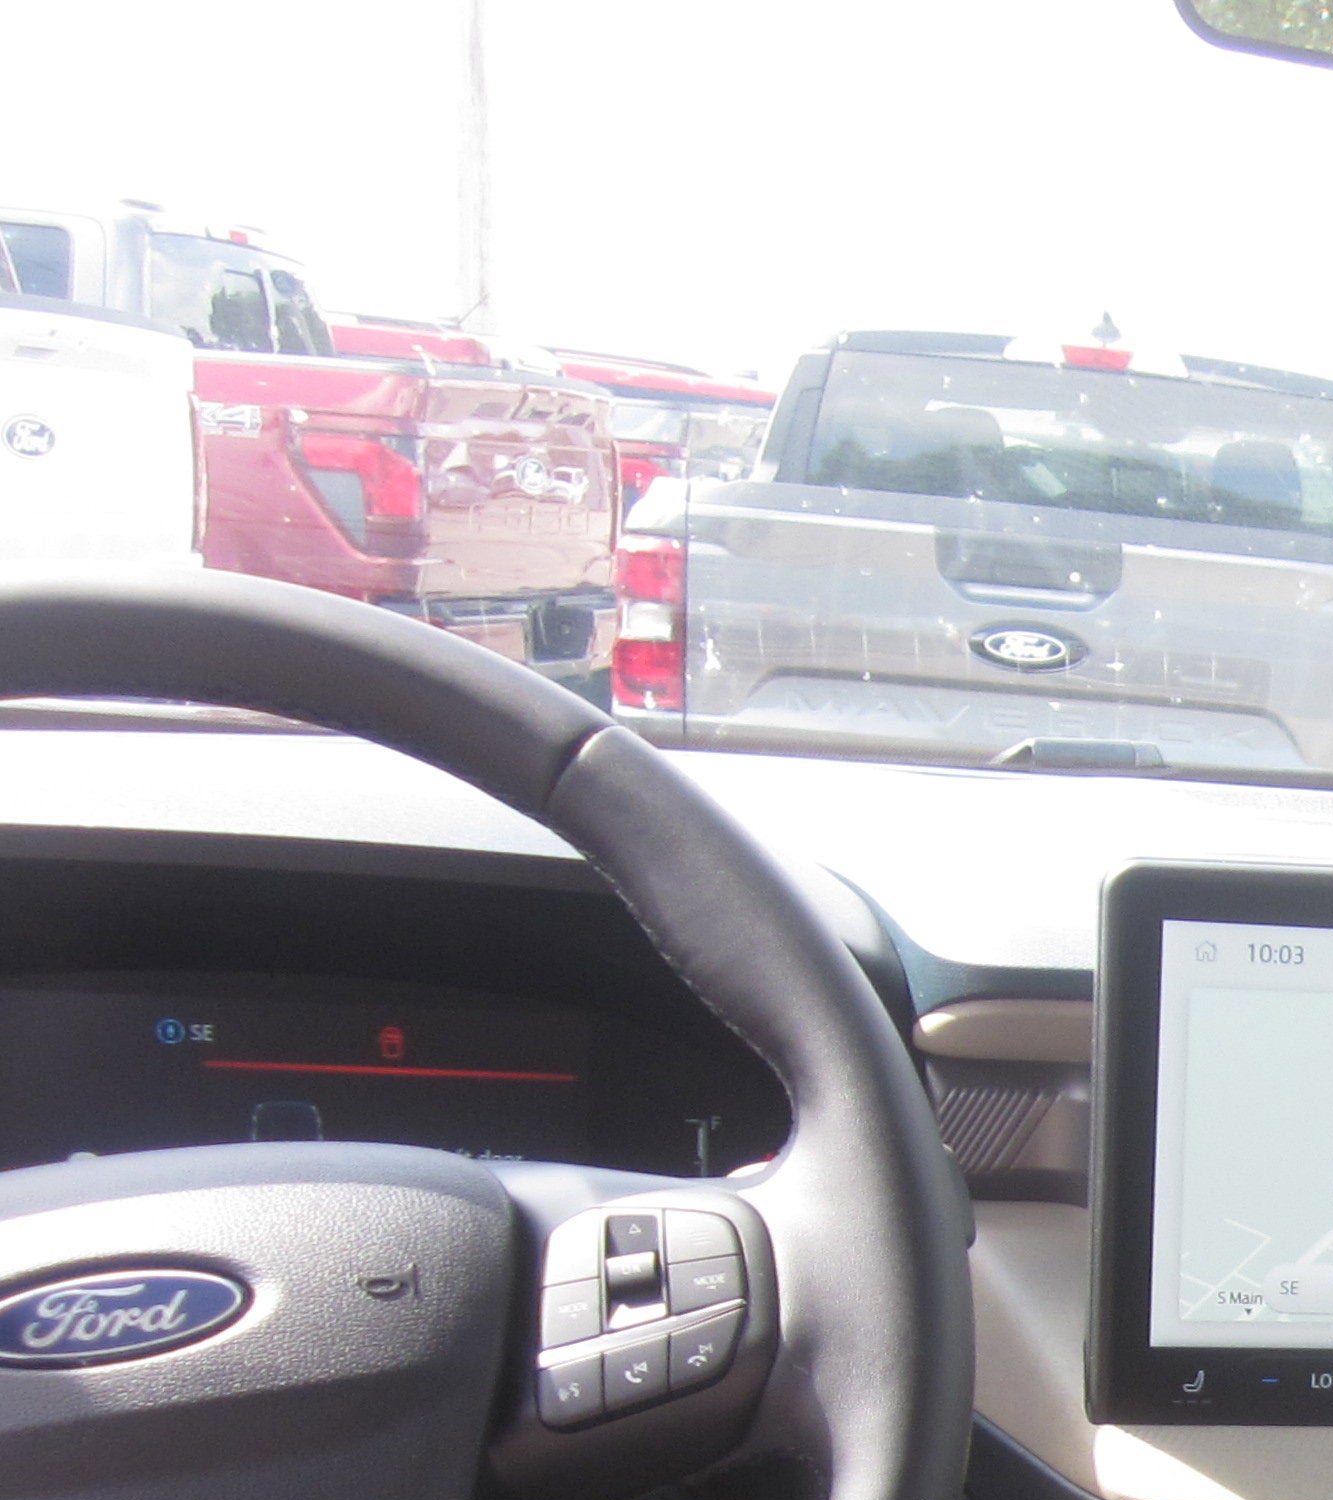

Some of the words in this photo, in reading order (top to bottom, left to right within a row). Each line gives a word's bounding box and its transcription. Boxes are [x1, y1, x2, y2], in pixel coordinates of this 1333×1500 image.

[1246, 943, 1306, 965] 10:03
[190, 1024, 215, 1042] SE
[1279, 1280, 1300, 1295] SE
[1217, 1291, 1227, 1304] S
[1229, 1292, 1264, 1306] Main
[22, 1282, 189, 1349] Ford
[1310, 1373, 1333, 1390] LO
